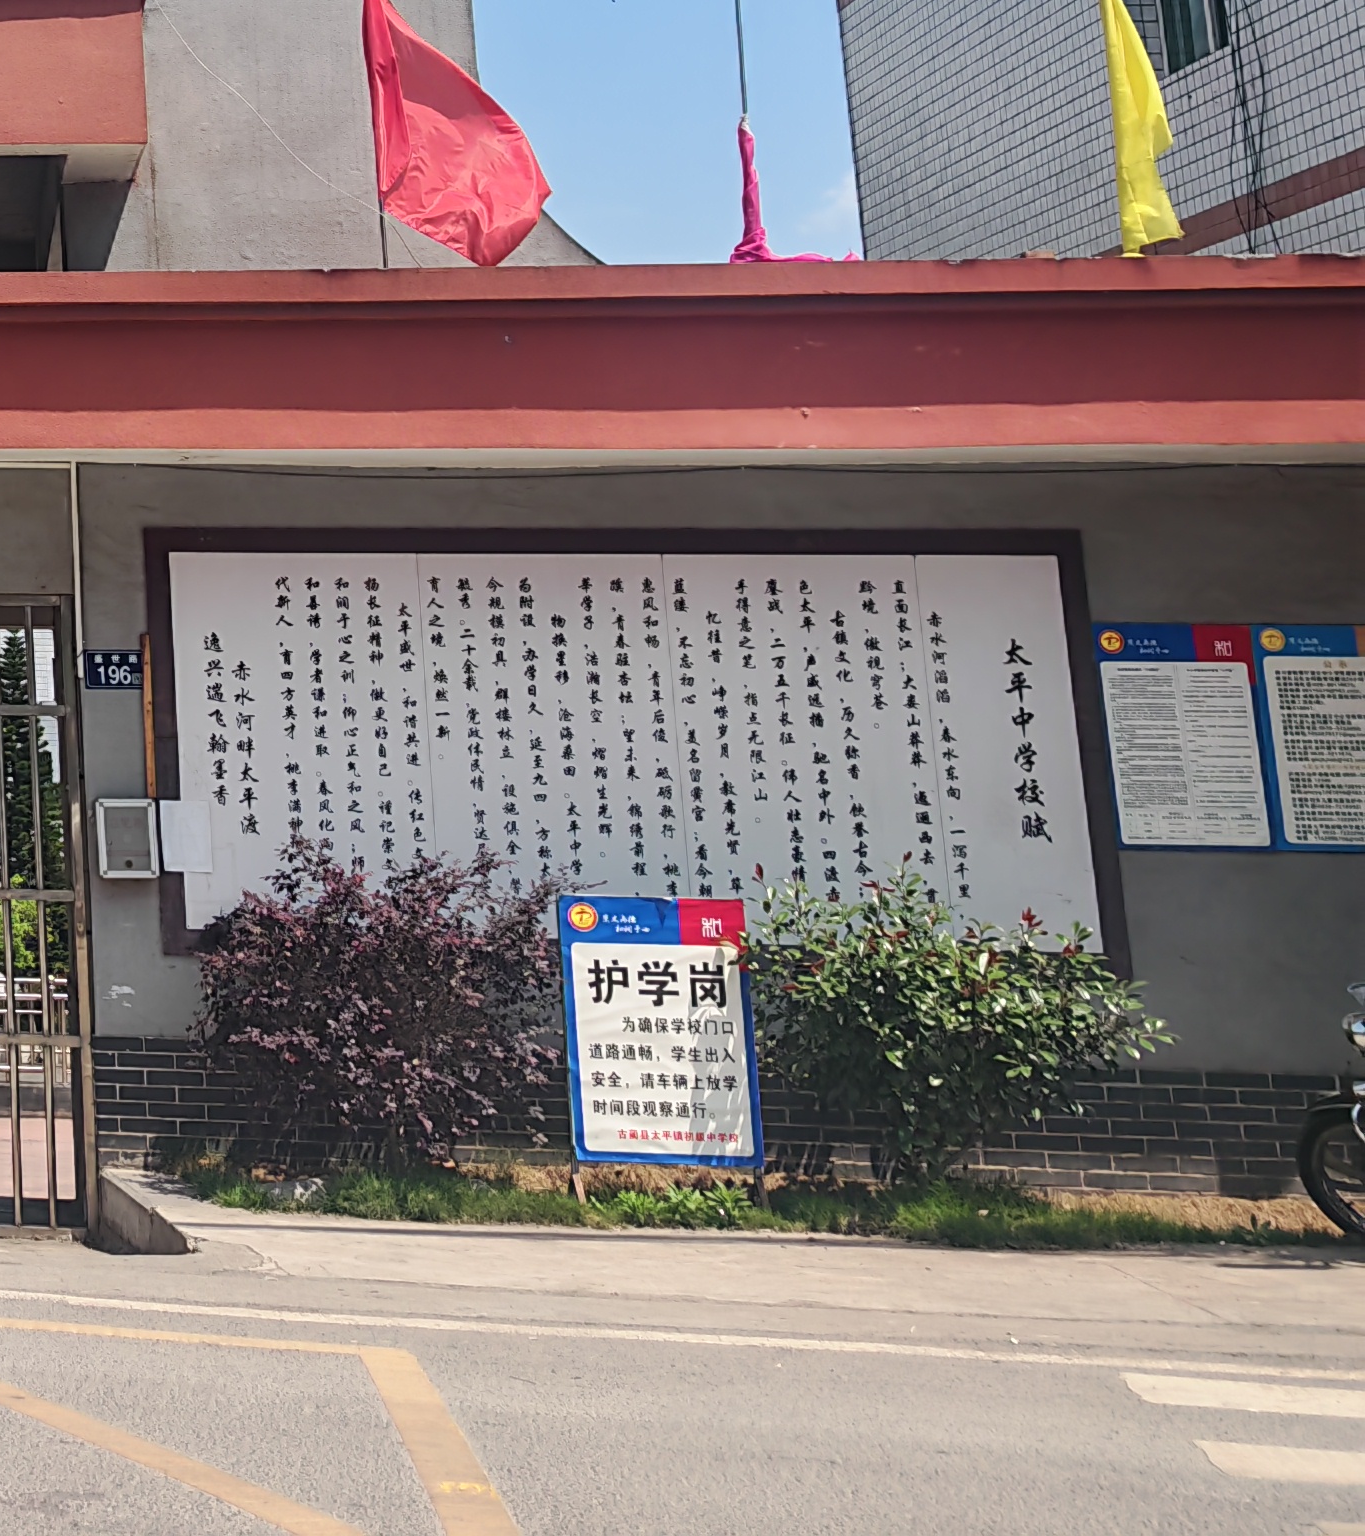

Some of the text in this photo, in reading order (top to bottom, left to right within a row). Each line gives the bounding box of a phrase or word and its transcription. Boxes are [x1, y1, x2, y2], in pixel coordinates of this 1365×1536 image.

[97, 665, 131, 684] 196
[203, 632, 230, 806] 逸兴遄飞翰墨香
[231, 661, 261, 835] 赤水河畔太平渡
[1002, 638, 1053, 843] 太平中学校赋
[588, 959, 728, 1008] 护学岗
[621, 1016, 735, 1035] 为确保学校门口
[588, 1043, 736, 1063] 道路通畅，学生出入
[591, 1071, 738, 1092] 安全，请车辆上放学
[592, 1099, 716, 1120] 时间段观察通行。
